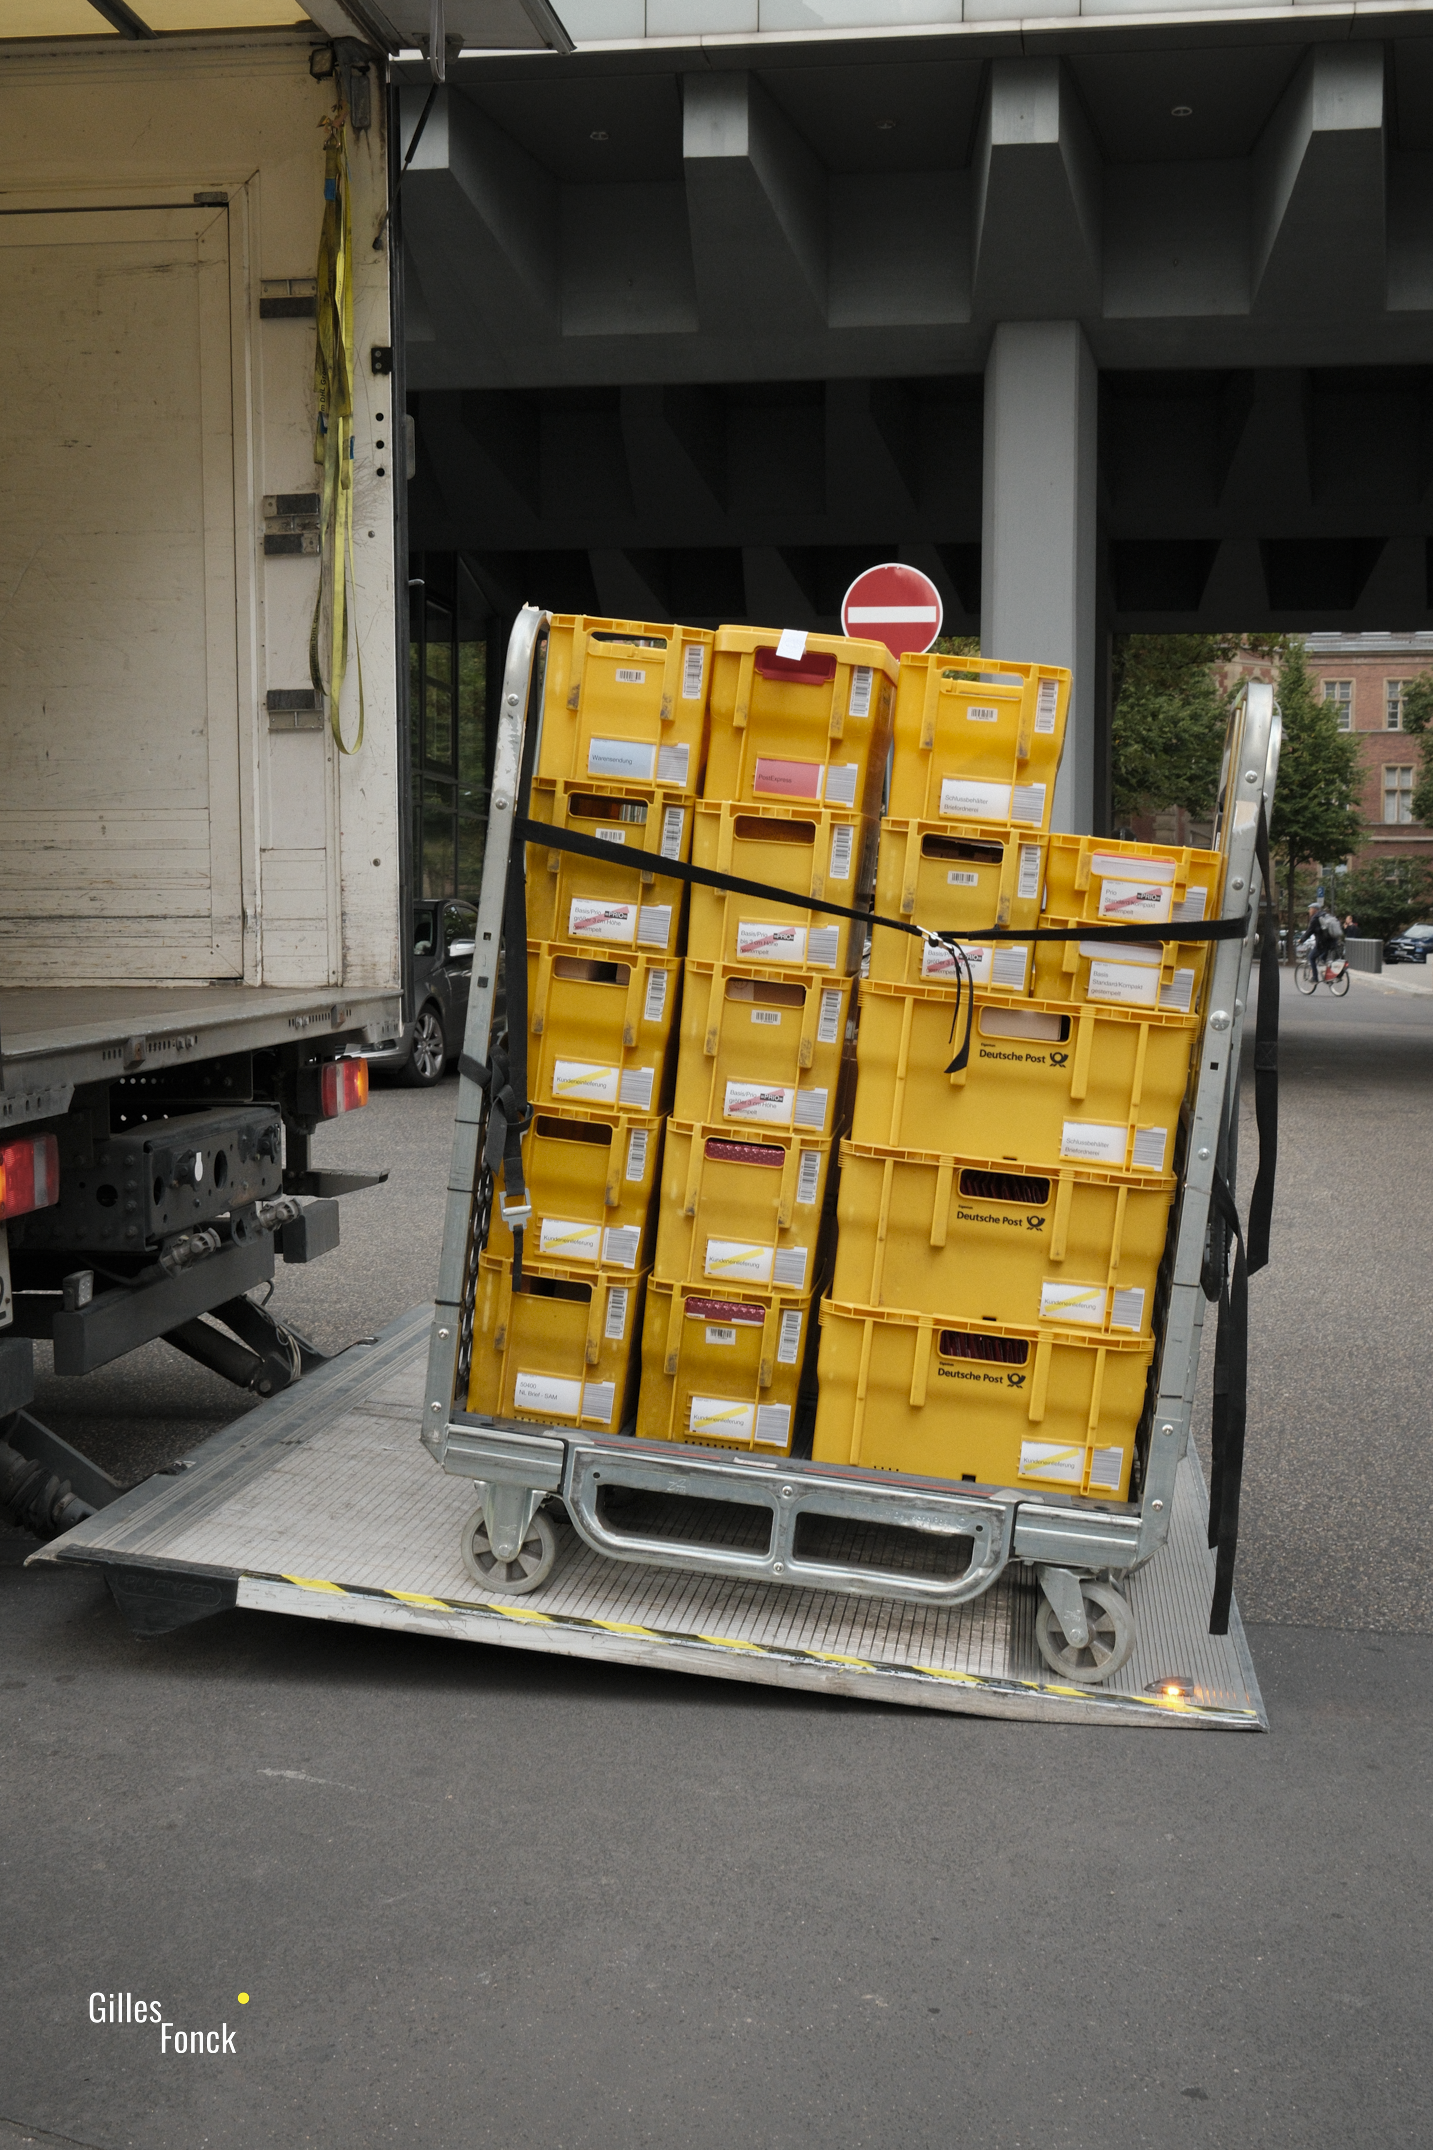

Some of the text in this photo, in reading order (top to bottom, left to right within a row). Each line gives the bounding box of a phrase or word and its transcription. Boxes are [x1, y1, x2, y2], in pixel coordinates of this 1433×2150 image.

[592, 754, 633, 765] Warensendung
[758, 774, 792, 783] PostExpress
[945, 794, 989, 805] Schlussbehälter
[944, 804, 979, 813] Briefordnerei
[1105, 888, 1117, 896] Prio
[574, 907, 602, 916] Basis/Prio
[740, 930, 768, 939] Basis/Prio
[1093, 970, 1109, 978] Basis
[1092, 979, 1144, 990] Standard/Kompakt
[1090, 988, 1122, 997] gestempelt
[979, 1049, 1046, 1064] Deutsche Post
[556, 1077, 607, 1089] Kundeneinlieferung
[729, 1089, 757, 1099] Basis/Prio
[1066, 1137, 1110, 1148] Schlussbehälter
[1065, 1146, 1100, 1156] Briefordnerei
[956, 1210, 1023, 1227] Deutsche Post
[543, 1235, 594, 1247] Kundeneinlieferung
[709, 1256, 760, 1269] Kundeneinlieferung
[1044, 1298, 1097, 1310] Kundeneinlieferung
[937, 1367, 1003, 1384] Deutsche Post
[693, 1414, 745, 1426] Kundeneinlieferung
[1023, 1457, 1076, 1469] Kundeneinlieferung
